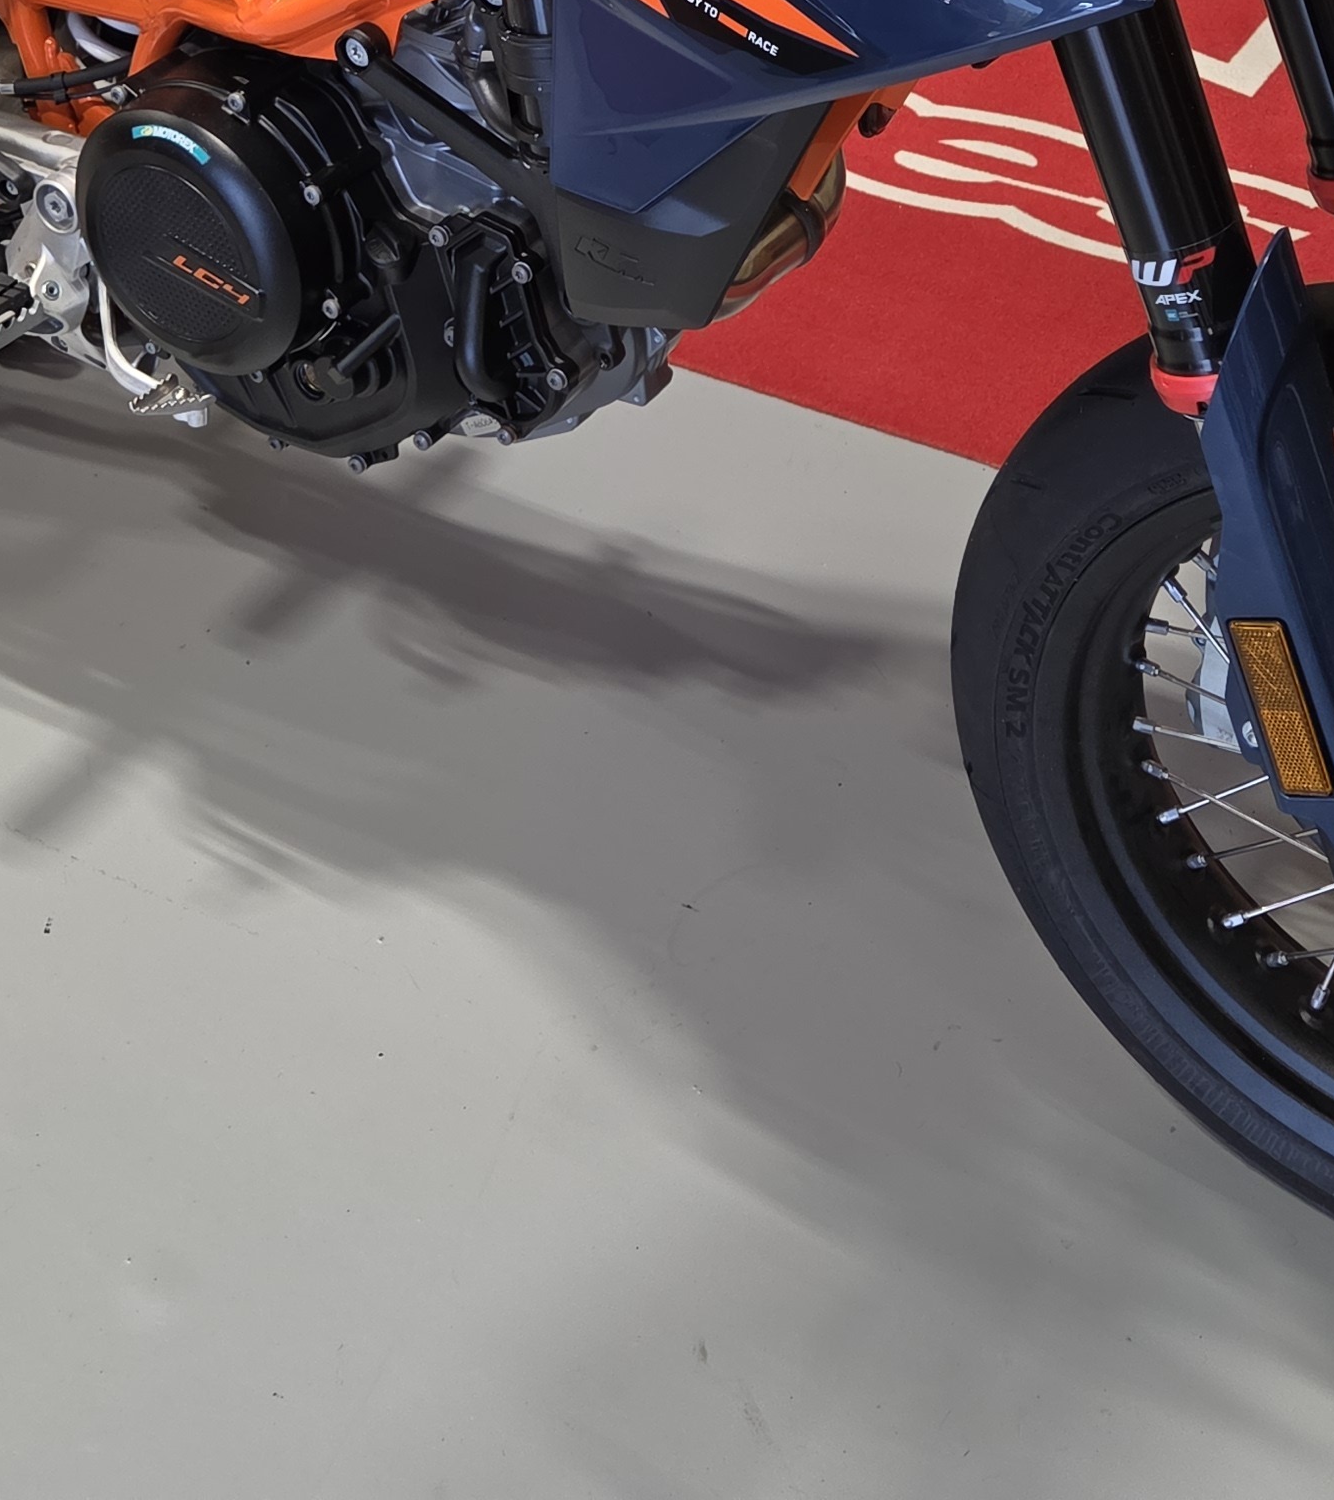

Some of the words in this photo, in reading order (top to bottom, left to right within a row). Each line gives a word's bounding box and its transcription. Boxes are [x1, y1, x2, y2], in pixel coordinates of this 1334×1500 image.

[703, 2, 719, 19] TO
[747, 31, 780, 57] RACE
[152, 125, 197, 154] MOTOREX
[172, 255, 250, 306] LC4
[1131, 246, 1217, 287] WP
[1155, 289, 1203, 306] APEX
